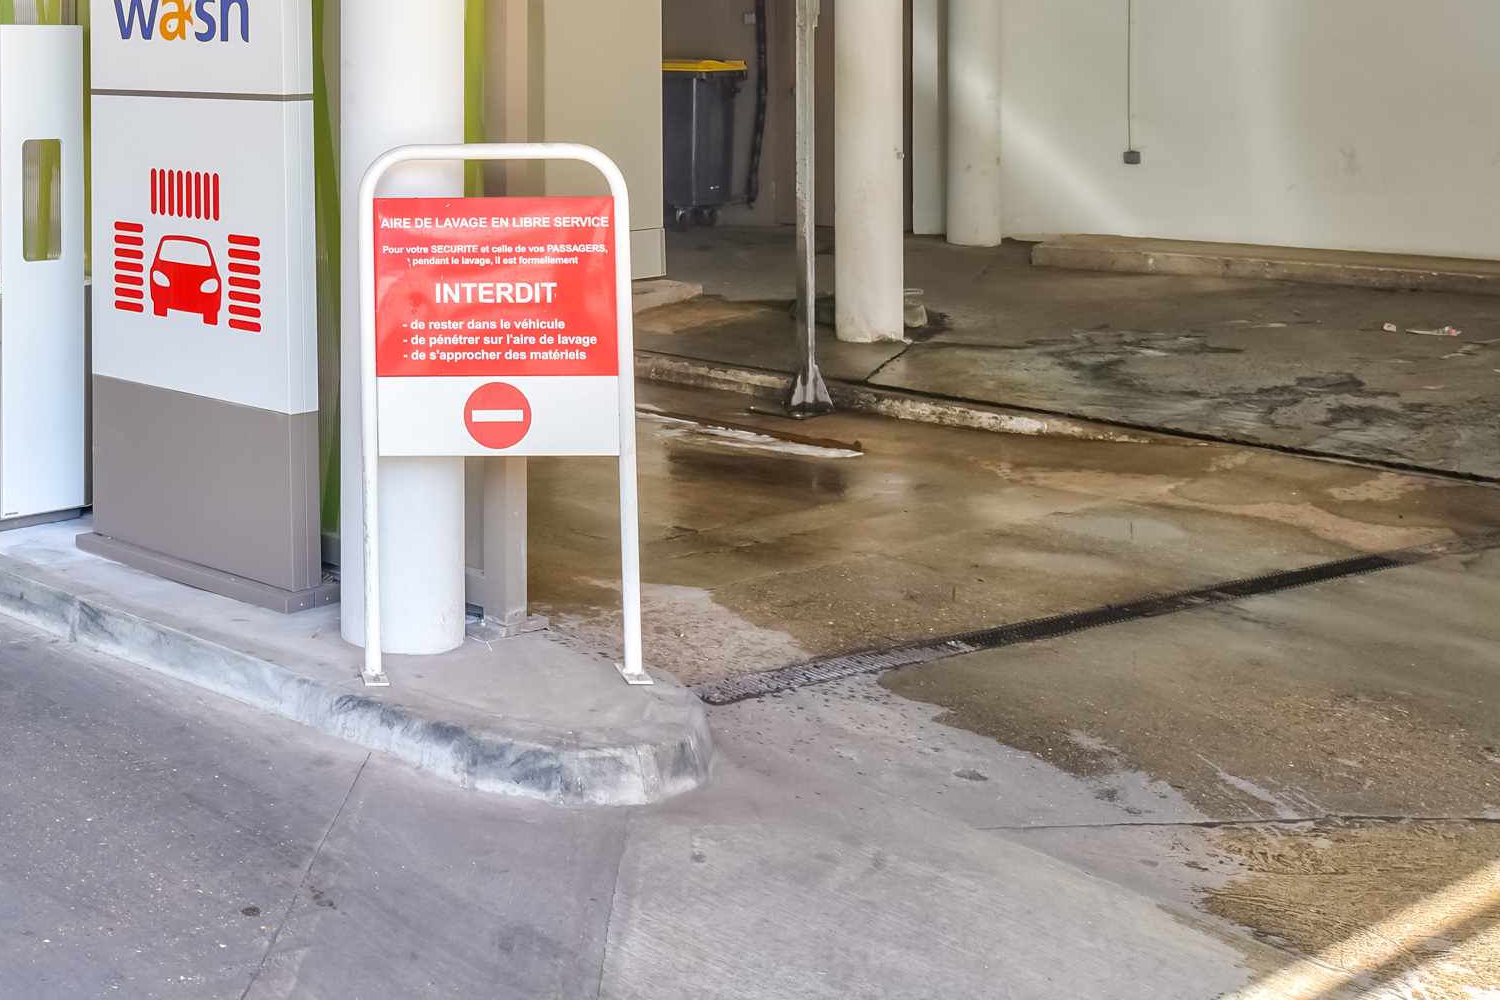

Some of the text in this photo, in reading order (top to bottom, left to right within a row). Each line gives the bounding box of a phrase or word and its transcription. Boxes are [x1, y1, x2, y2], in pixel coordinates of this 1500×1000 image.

[381, 216, 609, 228] AIRE DE LAVAGE EN LIBRE SERVICE
[382, 244, 608, 254] Pour votre SECURITE et celle de vos PASSAGERS,
[412, 257, 449, 266] pendant
[451, 257, 460, 265] le
[461, 257, 493, 267] lavage,
[495, 256, 500, 264] il
[518, 256, 579, 265] formellement
[435, 282, 557, 304] INTERDIT
[410, 319, 426, 330] de
[429, 319, 464, 330] rester
[467, 319, 497, 330] dans
[500, 318, 511, 330] le
[514, 318, 566, 330] véhicule
[410, 334, 426, 345] de
[429, 334, 480, 348] pénétrer
[483, 336, 504, 345] sur
[506, 334, 536, 345] l'aire
[539, 334, 554, 345] de
[557, 333, 598, 347] lavage
[411, 350, 426, 360] de
[429, 349, 502, 363] s'approcher
[504, 349, 527, 360] des
[529, 349, 587, 360] matériels
